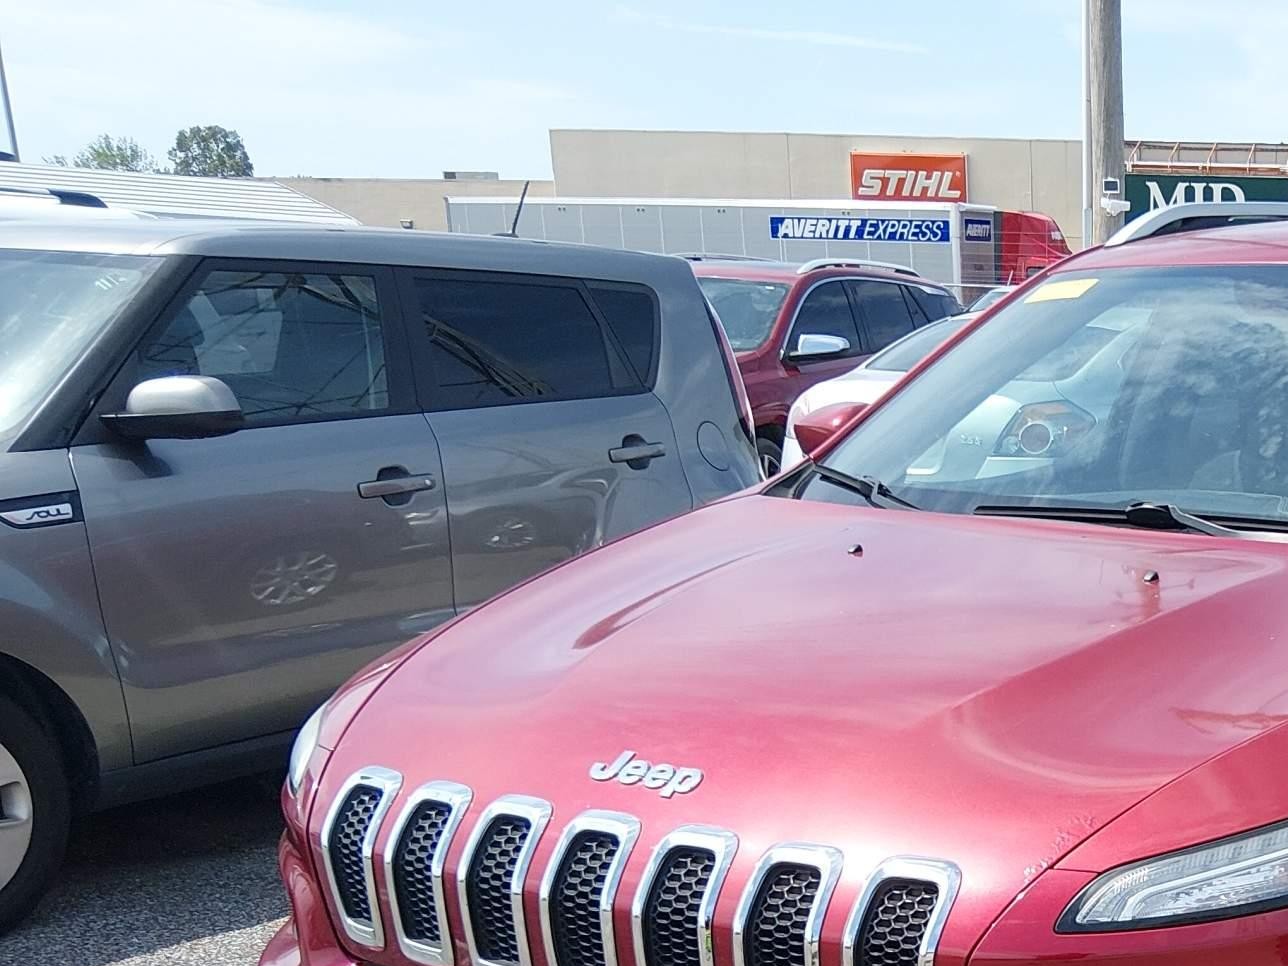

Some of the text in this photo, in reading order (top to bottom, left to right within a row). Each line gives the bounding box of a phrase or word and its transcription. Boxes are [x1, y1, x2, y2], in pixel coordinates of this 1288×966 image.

[858, 169, 961, 198] STIHL
[780, 218, 944, 241] AVERITT EXPRESS
[589, 750, 704, 799] Jeep
